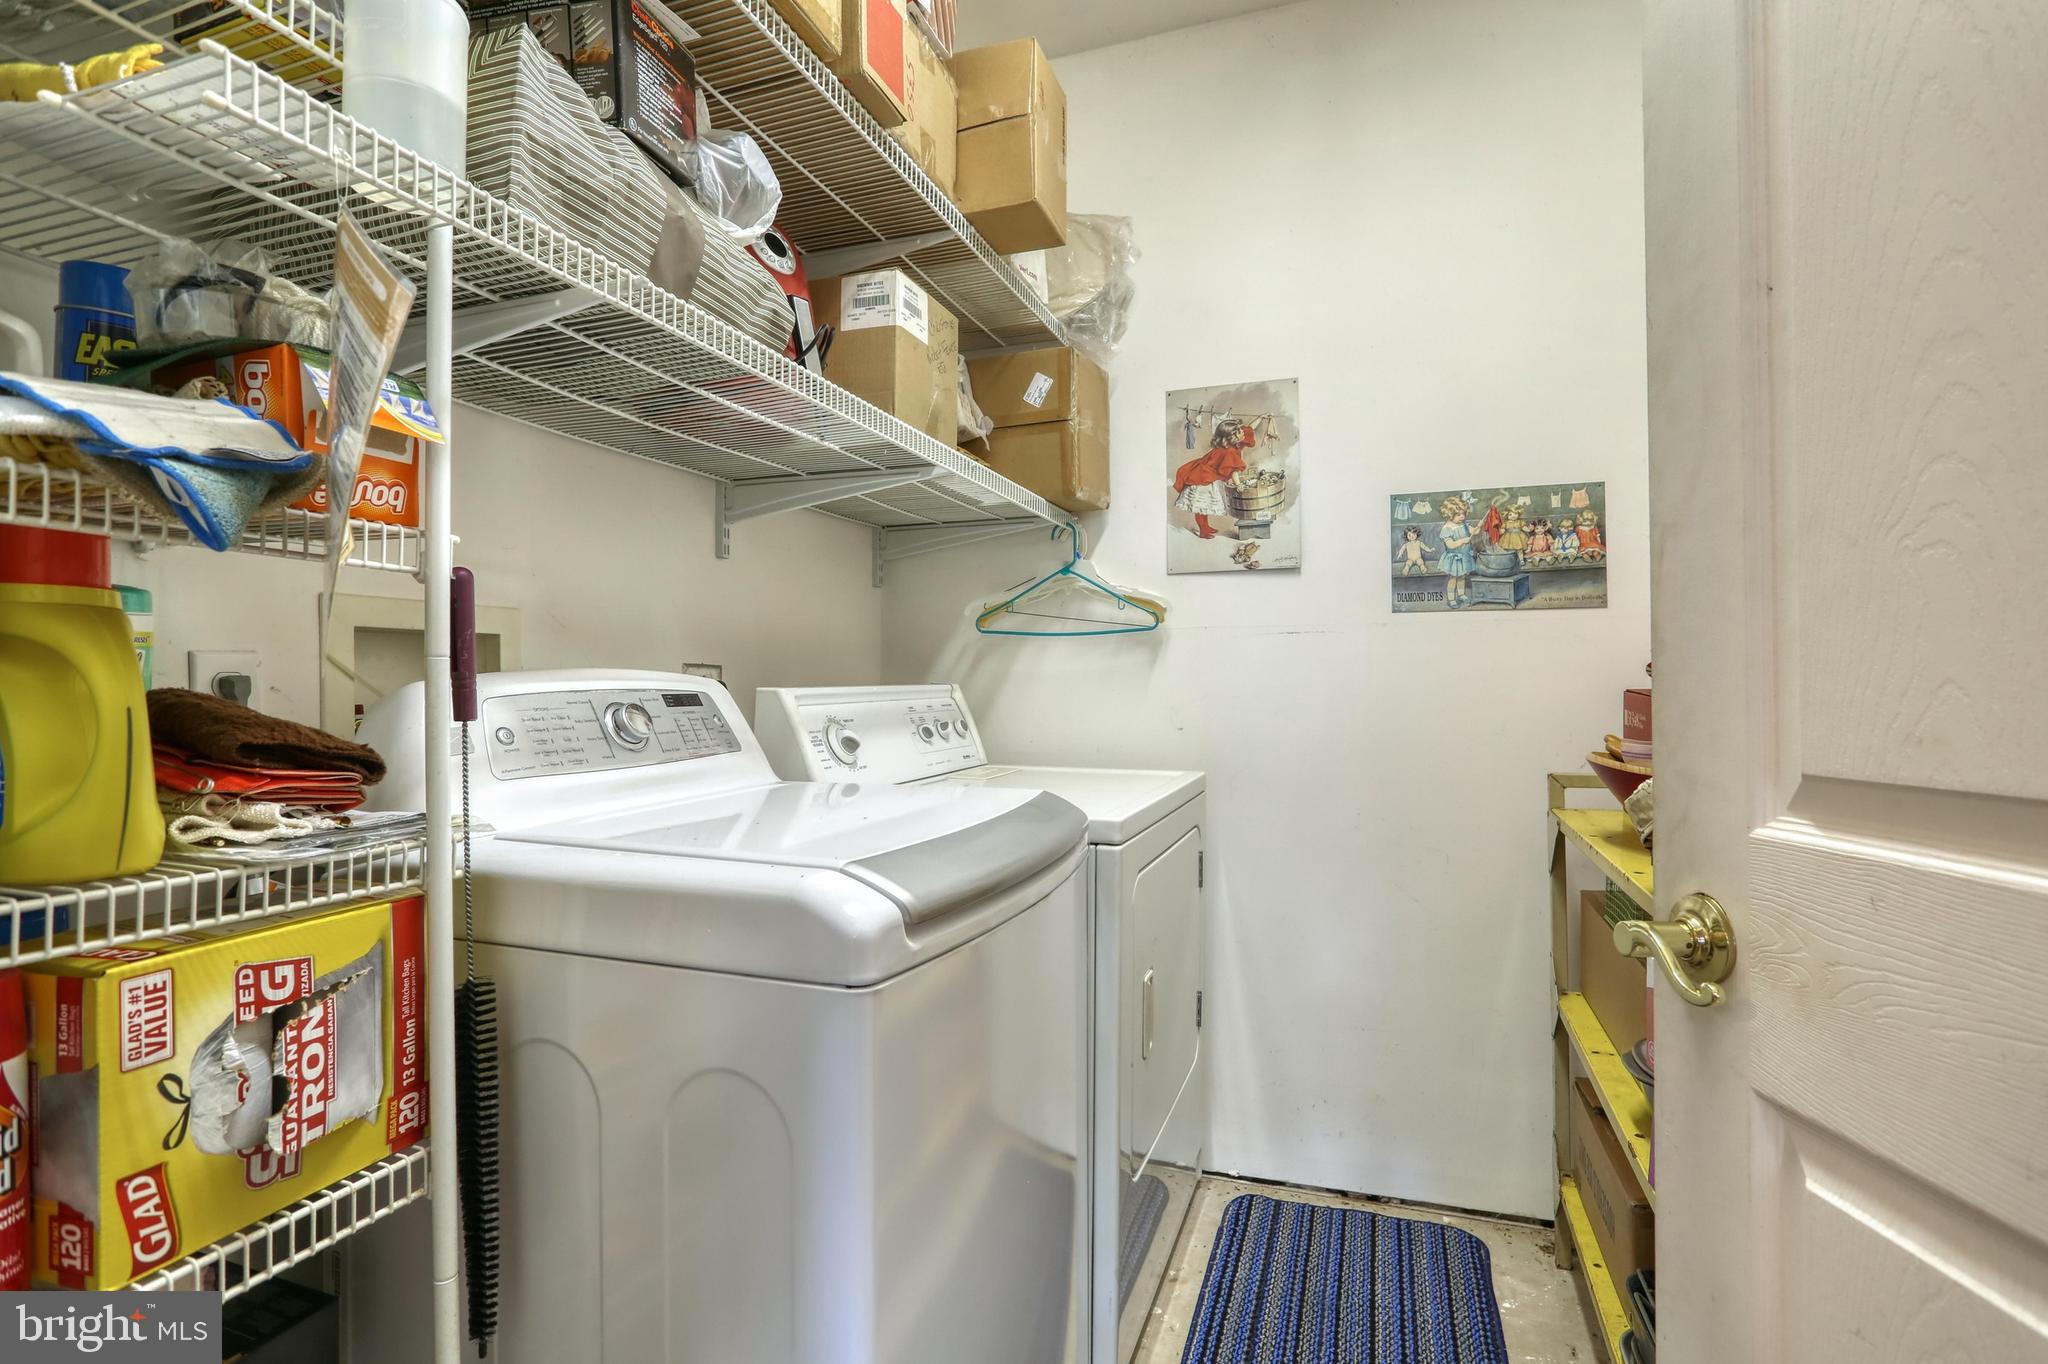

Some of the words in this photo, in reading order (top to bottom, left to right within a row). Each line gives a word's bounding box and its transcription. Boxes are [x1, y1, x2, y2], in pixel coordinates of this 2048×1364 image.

[1396, 591, 1426, 603] DIAMOND
[1427, 591, 1444, 602] DYES
[402, 958, 412, 977] Bags
[128, 986, 142, 1005] #1
[402, 977, 410, 1005] Kitchen
[144, 980, 167, 1058] VALUE
[402, 1005, 411, 1019] Tall
[128, 1009, 142, 1062] GLAD'S
[402, 1018, 416, 1066] Gallon
[402, 1067, 416, 1087] 13
[398, 1091, 420, 1134] 120
[127, 1175, 173, 1263] GLAD
[60, 1223, 82, 1270] 120
